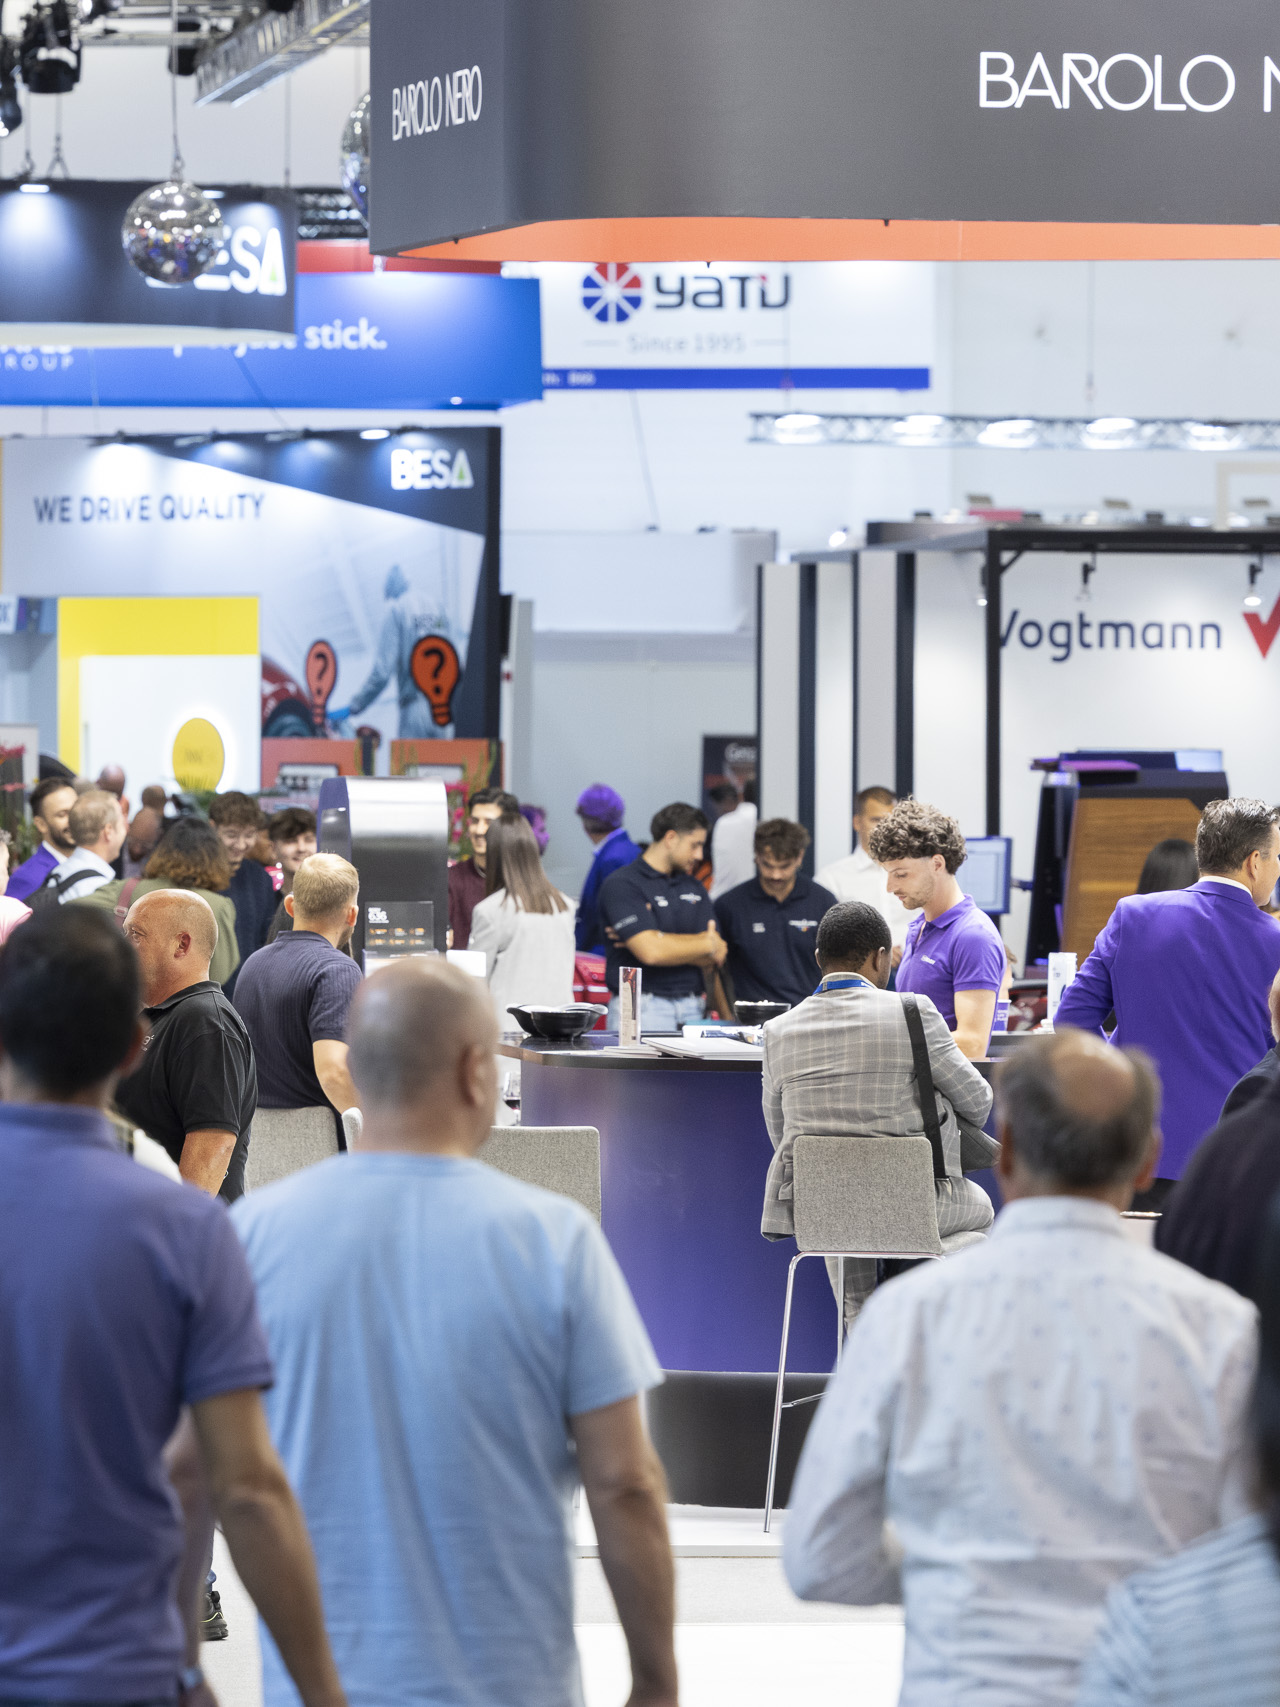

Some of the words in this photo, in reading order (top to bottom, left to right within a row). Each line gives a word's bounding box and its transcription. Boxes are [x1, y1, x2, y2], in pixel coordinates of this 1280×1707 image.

[392, 76, 442, 141] BAROLO
[445, 64, 483, 127] NERO
[979, 51, 1236, 113] BAROLO
[304, 317, 388, 350] stick.
[390, 448, 474, 491] BESA
[33, 494, 72, 523] WE
[80, 494, 151, 523] DRIVE
[158, 490, 265, 522] QUALITY
[999, 609, 1222, 662] Vogtmann
